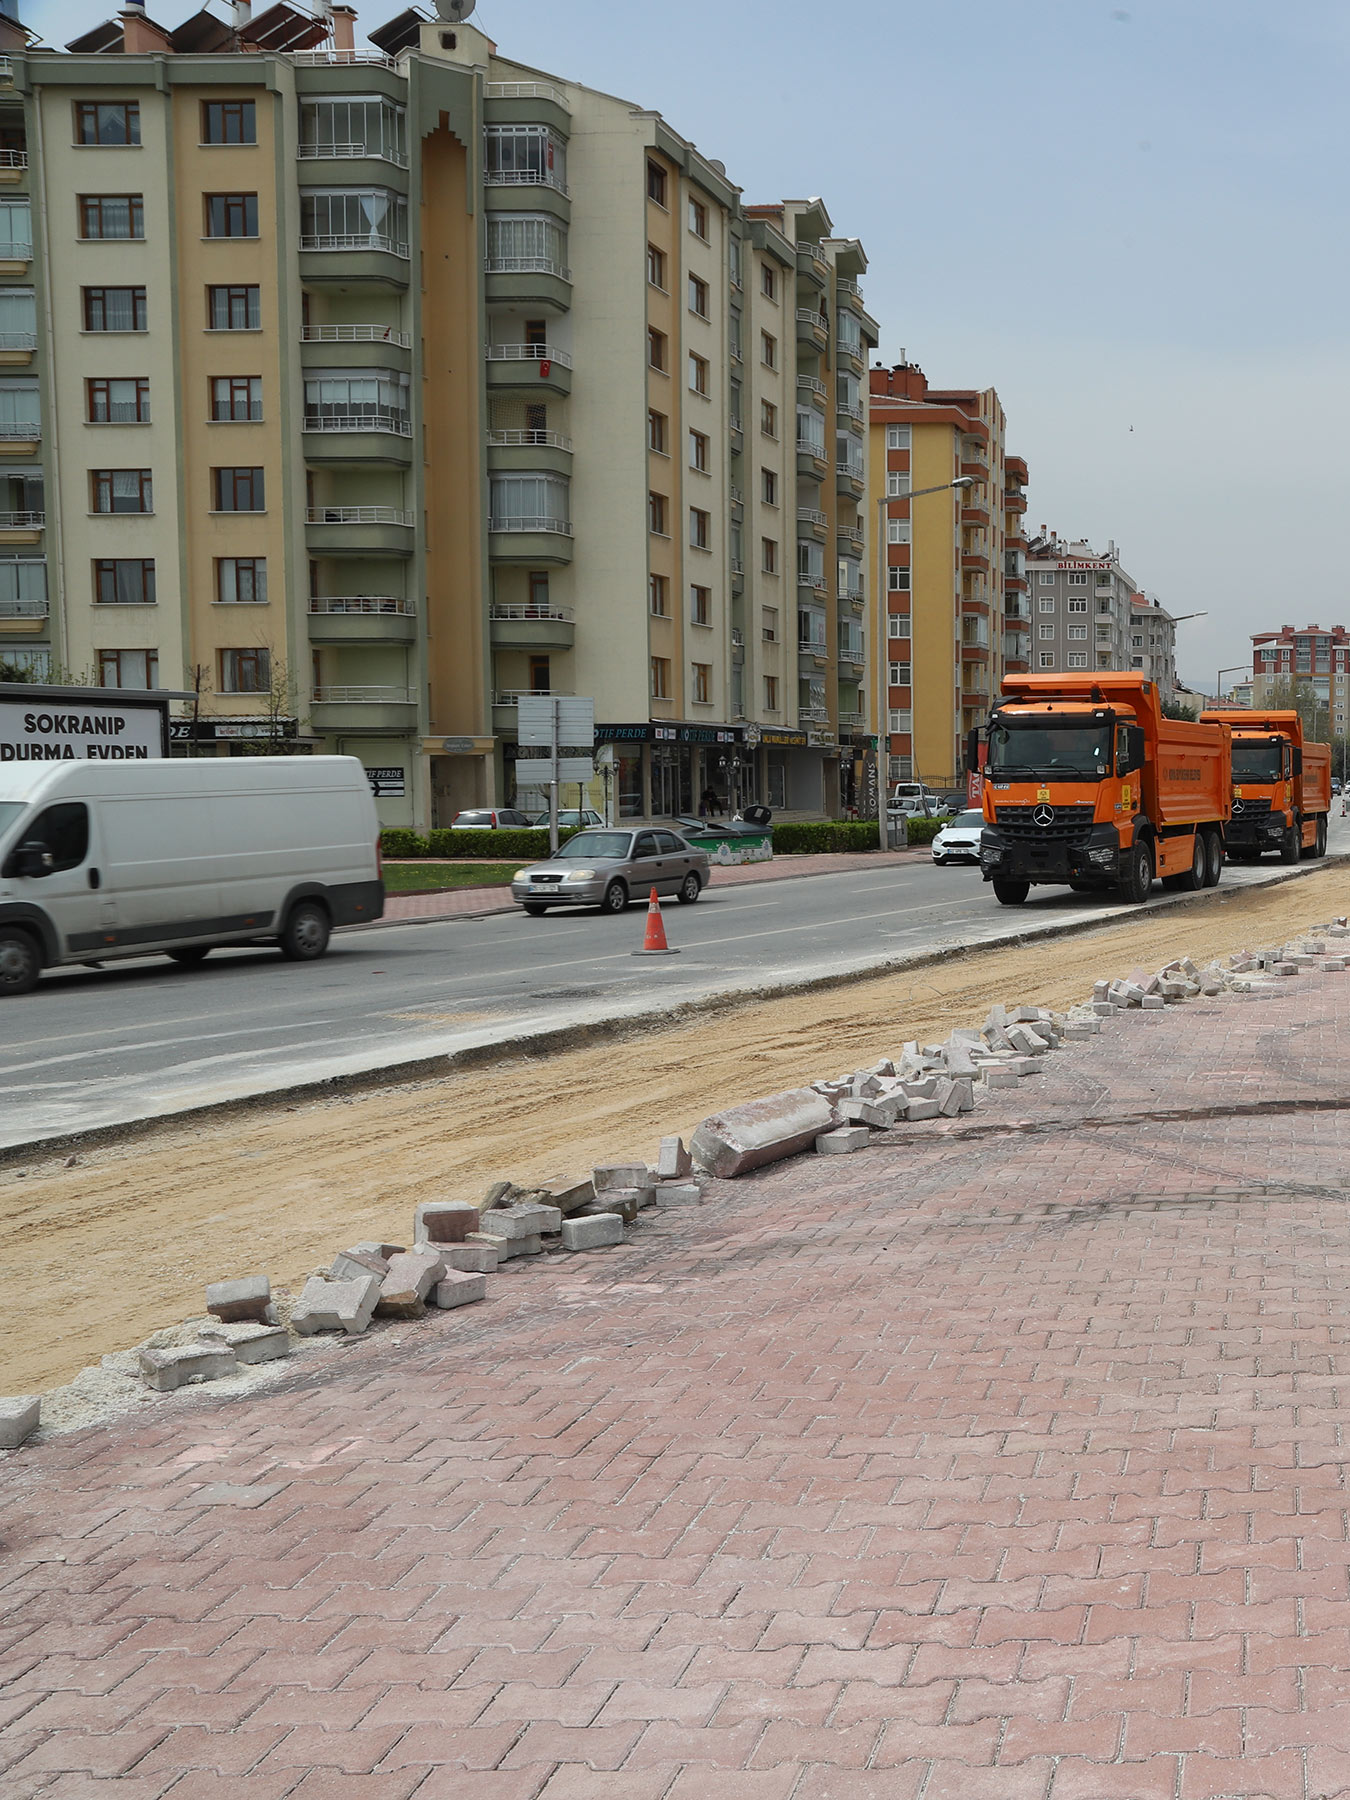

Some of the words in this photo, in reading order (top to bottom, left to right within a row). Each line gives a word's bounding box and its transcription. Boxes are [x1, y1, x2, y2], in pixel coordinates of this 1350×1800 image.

[24, 713, 126, 735] SOKRANIP
[616, 728, 647, 739] PERDE
[87, 744, 148, 760] EVDEN
